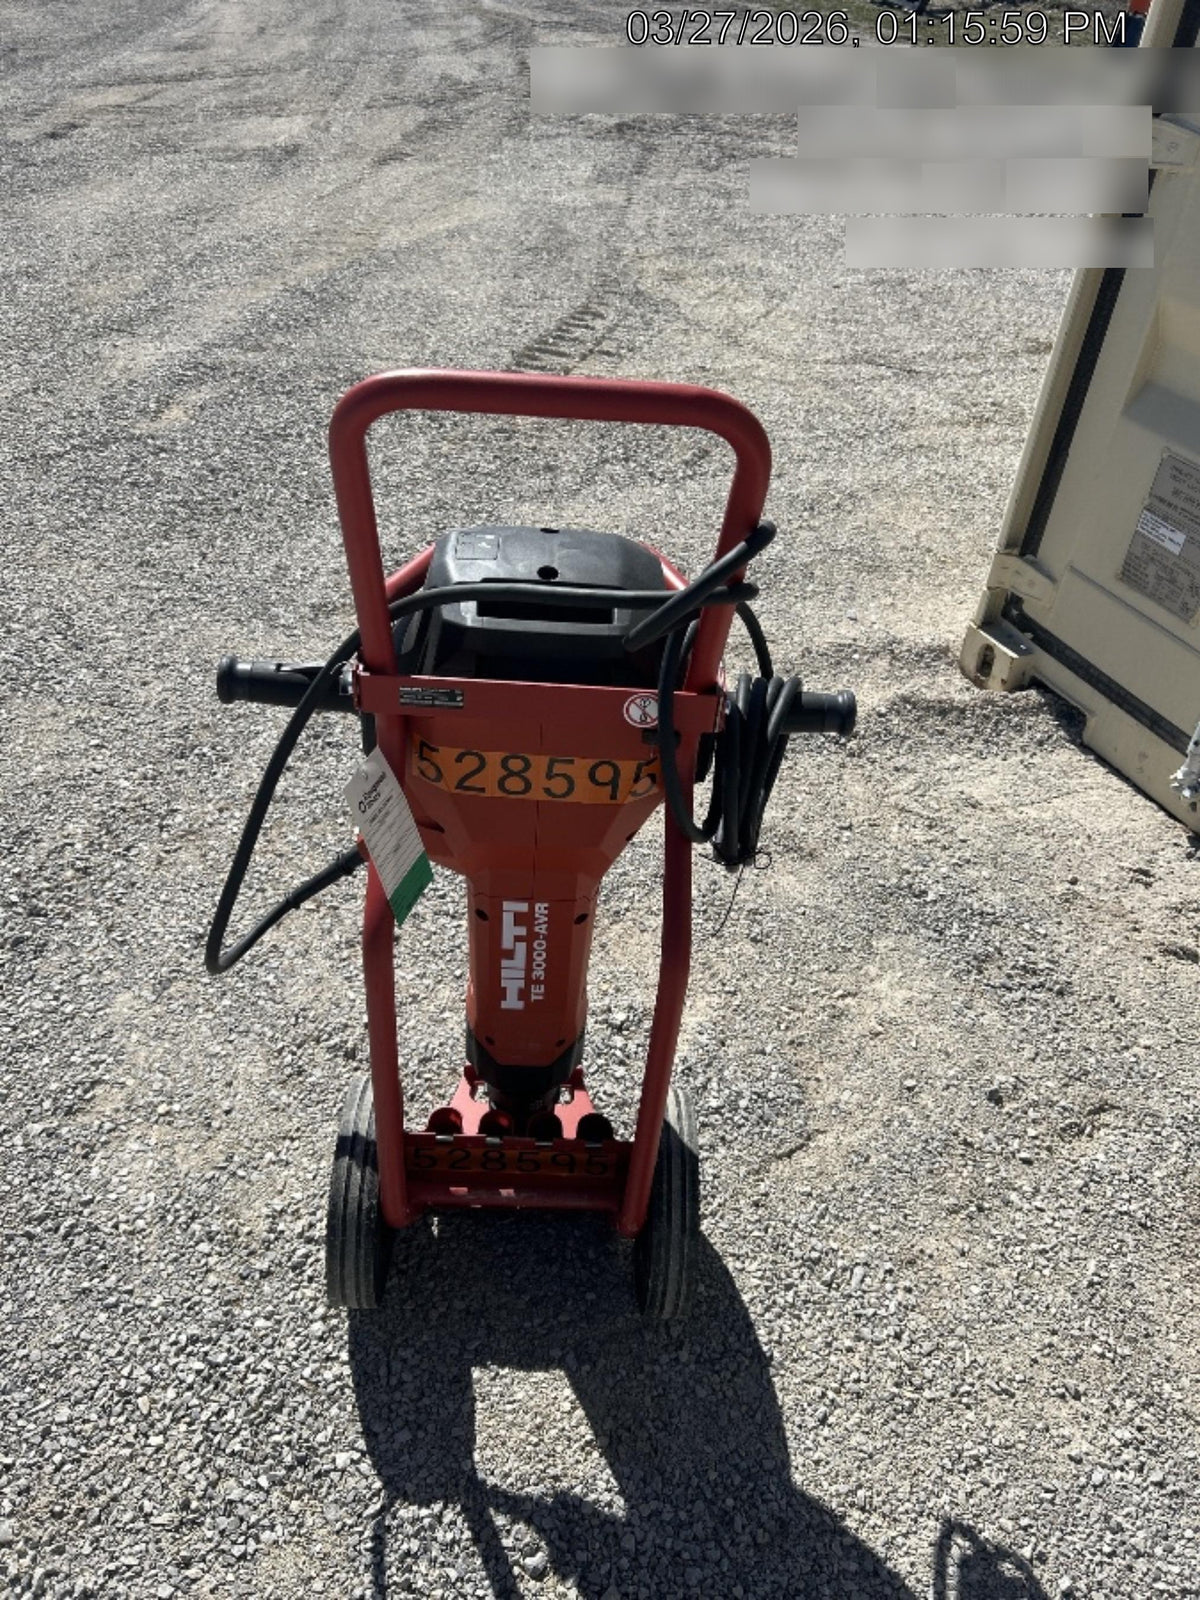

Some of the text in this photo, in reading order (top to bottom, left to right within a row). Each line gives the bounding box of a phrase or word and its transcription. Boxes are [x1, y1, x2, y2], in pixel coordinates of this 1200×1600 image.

[417, 739, 658, 800] 528595
[500, 901, 529, 1010] HILTI
[531, 903, 550, 1002] TE 3000-AVR
[412, 1147, 609, 1176] 528595
